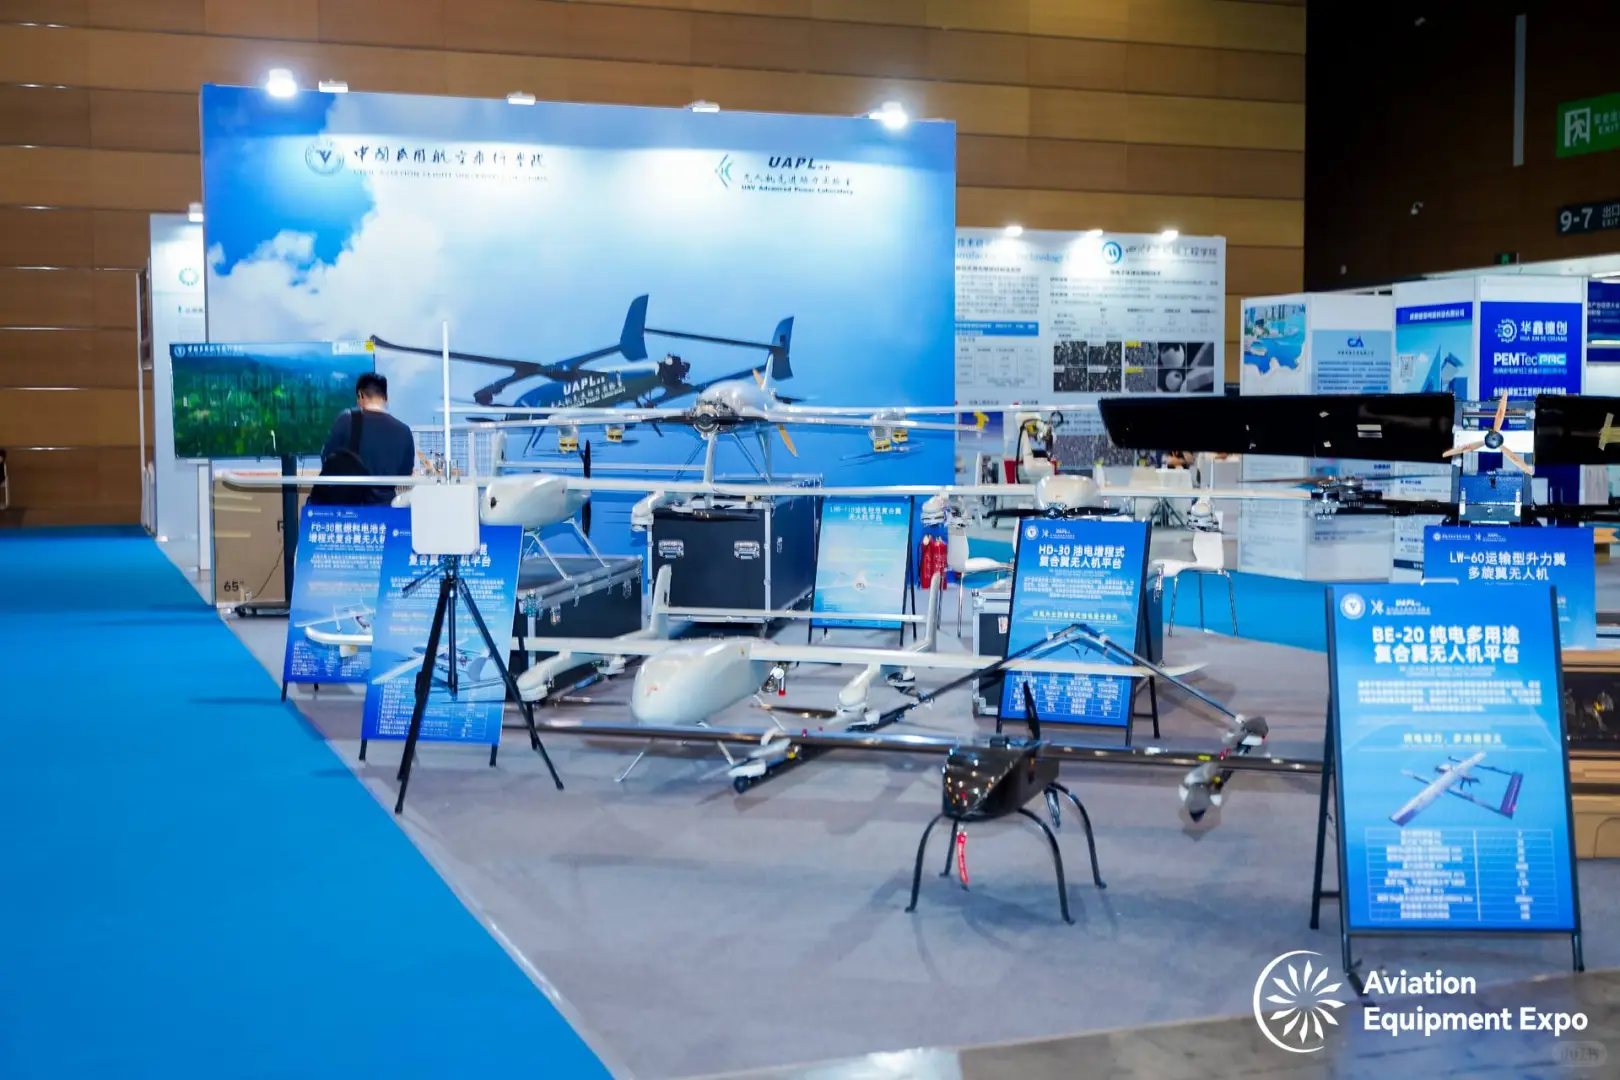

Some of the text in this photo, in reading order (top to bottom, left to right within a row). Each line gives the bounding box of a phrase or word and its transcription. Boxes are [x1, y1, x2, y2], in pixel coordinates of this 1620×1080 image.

[1602, 204, 1620, 218] 出口
[1560, 208, 1593, 232] 9-7
[1493, 352, 1538, 366] PEMTec
[1039, 544, 1070, 556] HD-30
[1039, 555, 1122, 569] 复合翼无人机平台
[1449, 551, 1567, 567] LW-60运输型升力翼
[1468, 566, 1550, 581] 多旋翼无人机
[1372, 624, 1520, 645] BE-20 纯电多用途
[1374, 644, 1519, 664] 复合翼无人机平台
